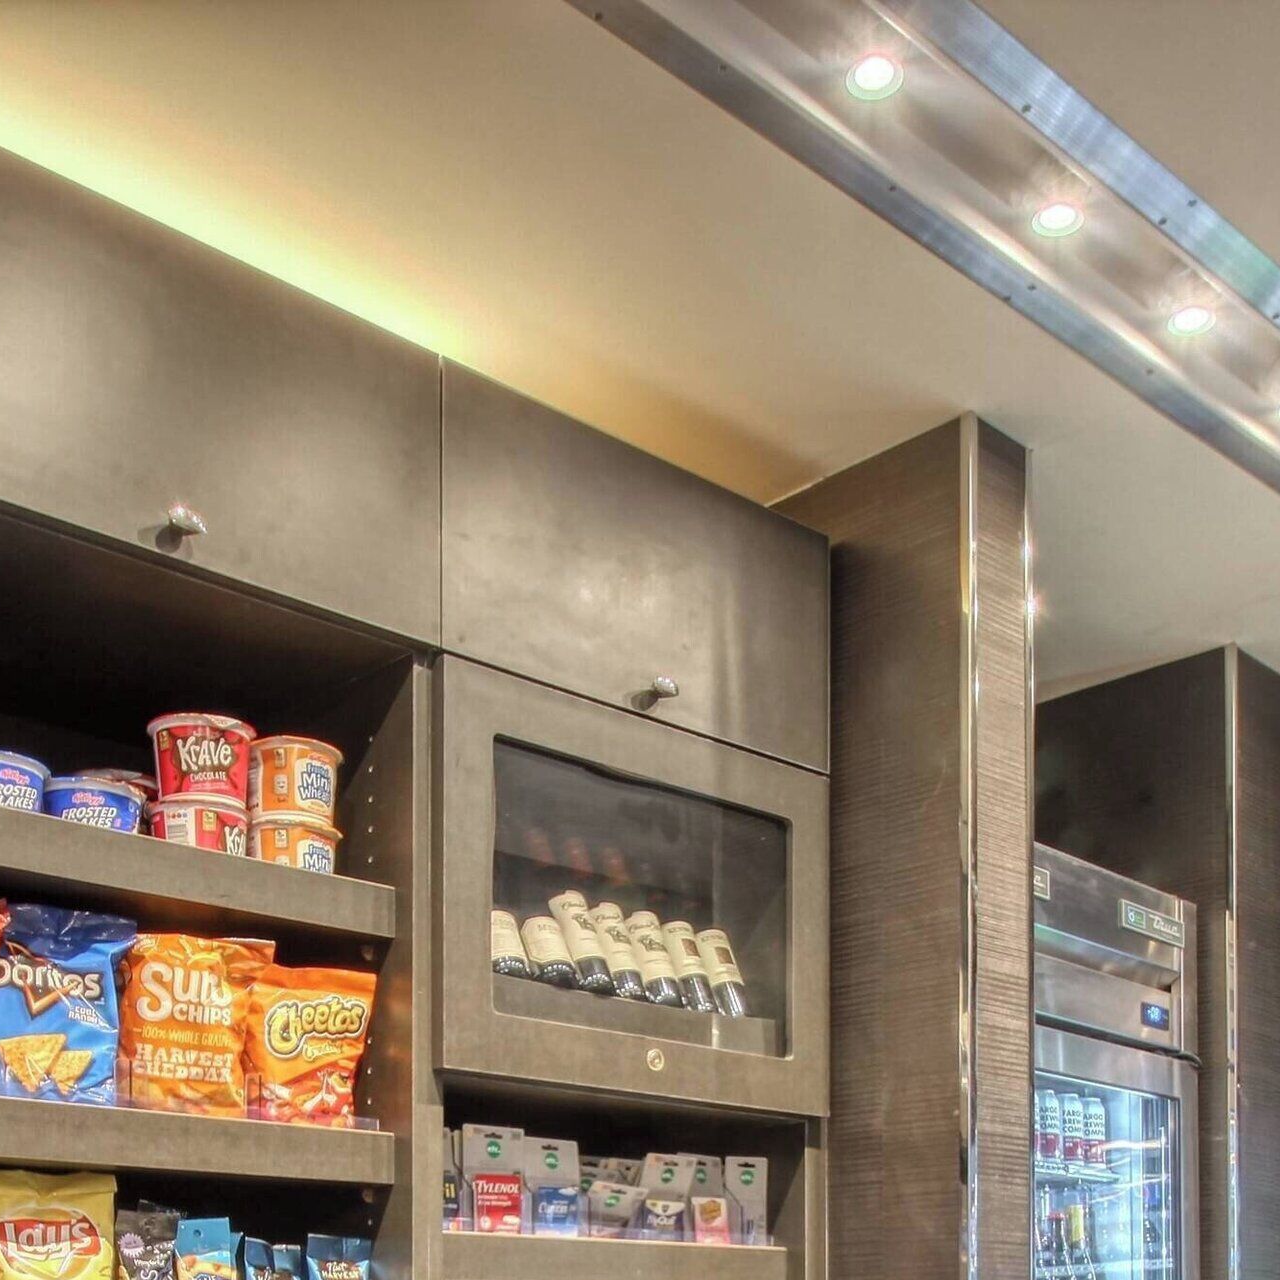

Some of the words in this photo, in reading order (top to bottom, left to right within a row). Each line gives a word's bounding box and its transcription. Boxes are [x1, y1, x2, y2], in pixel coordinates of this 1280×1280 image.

[61, 806, 118, 821] FROSTED
[172, 1005, 232, 1027] CHIPS
[265, 995, 368, 1059] Cheetos
[168, 1030, 200, 1046] WHOLE
[134, 1043, 234, 1068] HARVEST
[133, 1060, 233, 1084] CHEDDAR
[476, 1179, 520, 1194] TYLENOL
[3, 1215, 92, 1262] Lay's
[321, 1268, 361, 1280] HARVEST
